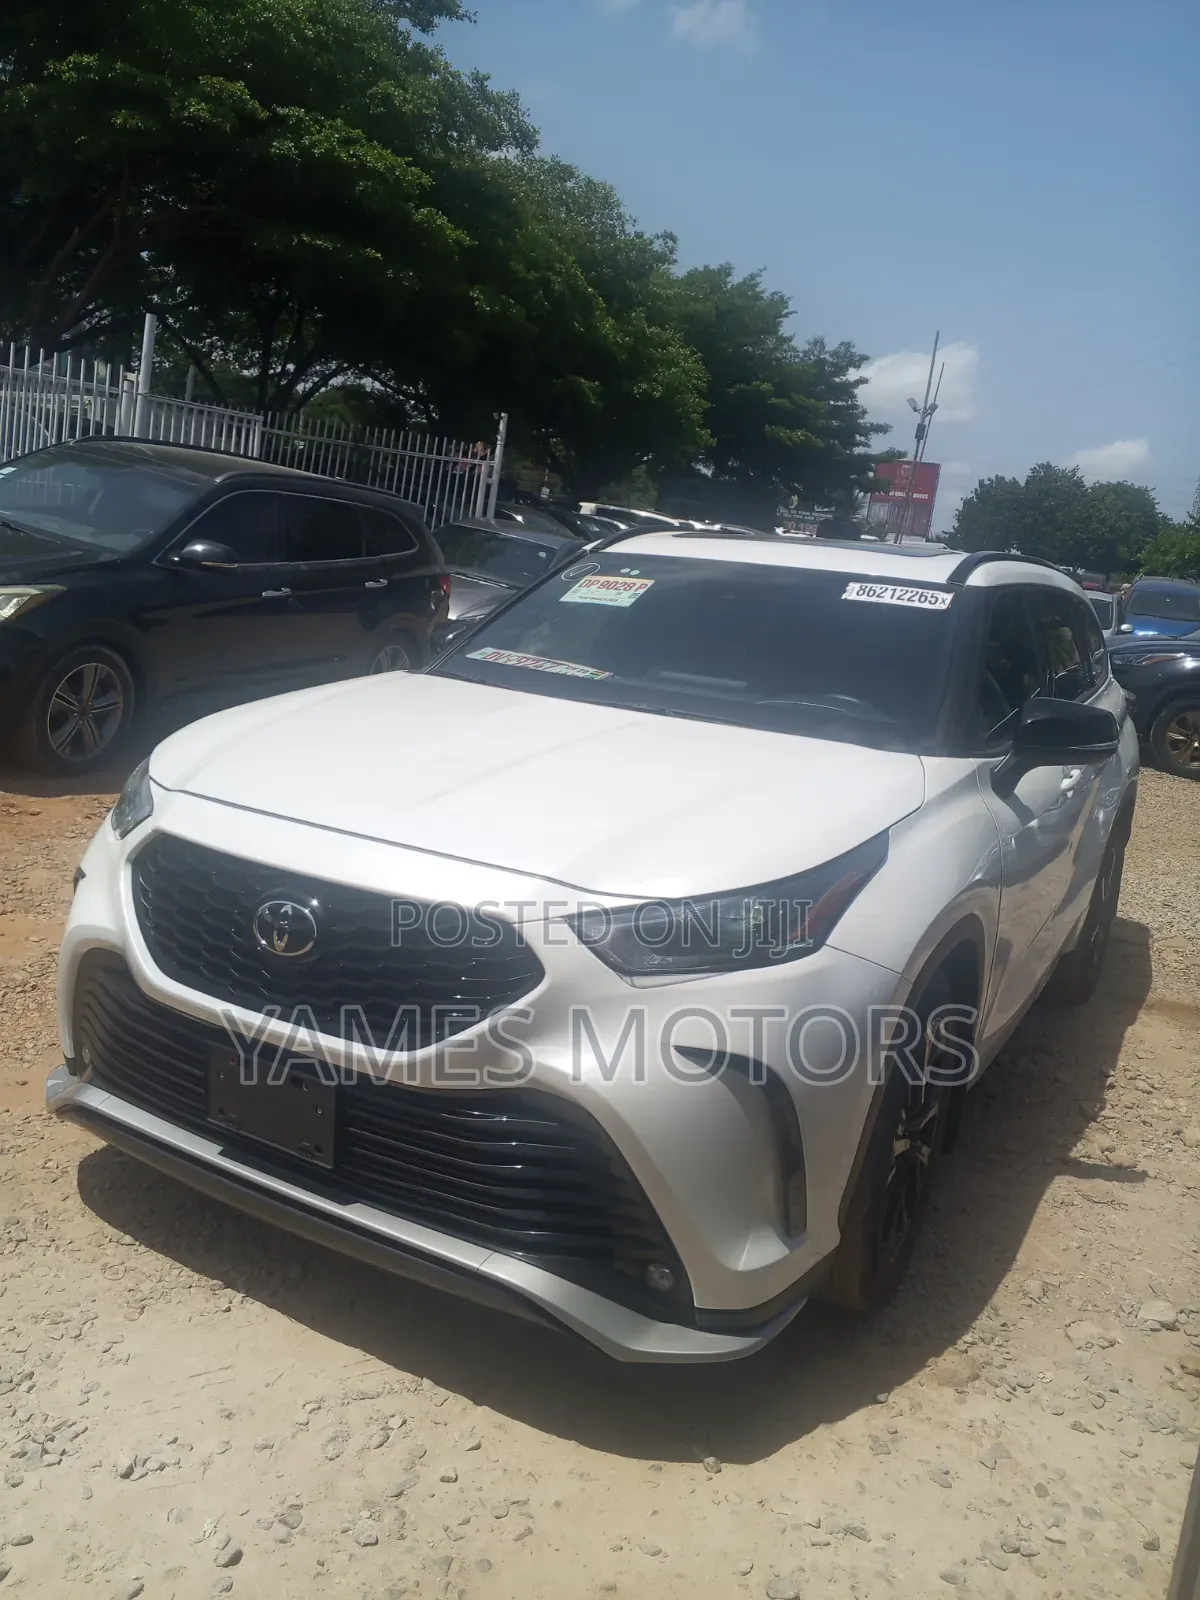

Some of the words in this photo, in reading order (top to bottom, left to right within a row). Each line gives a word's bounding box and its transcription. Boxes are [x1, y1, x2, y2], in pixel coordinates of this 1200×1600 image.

[578, 579, 598, 589] DP
[597, 580, 636, 592] 9028
[634, 583, 648, 592] P
